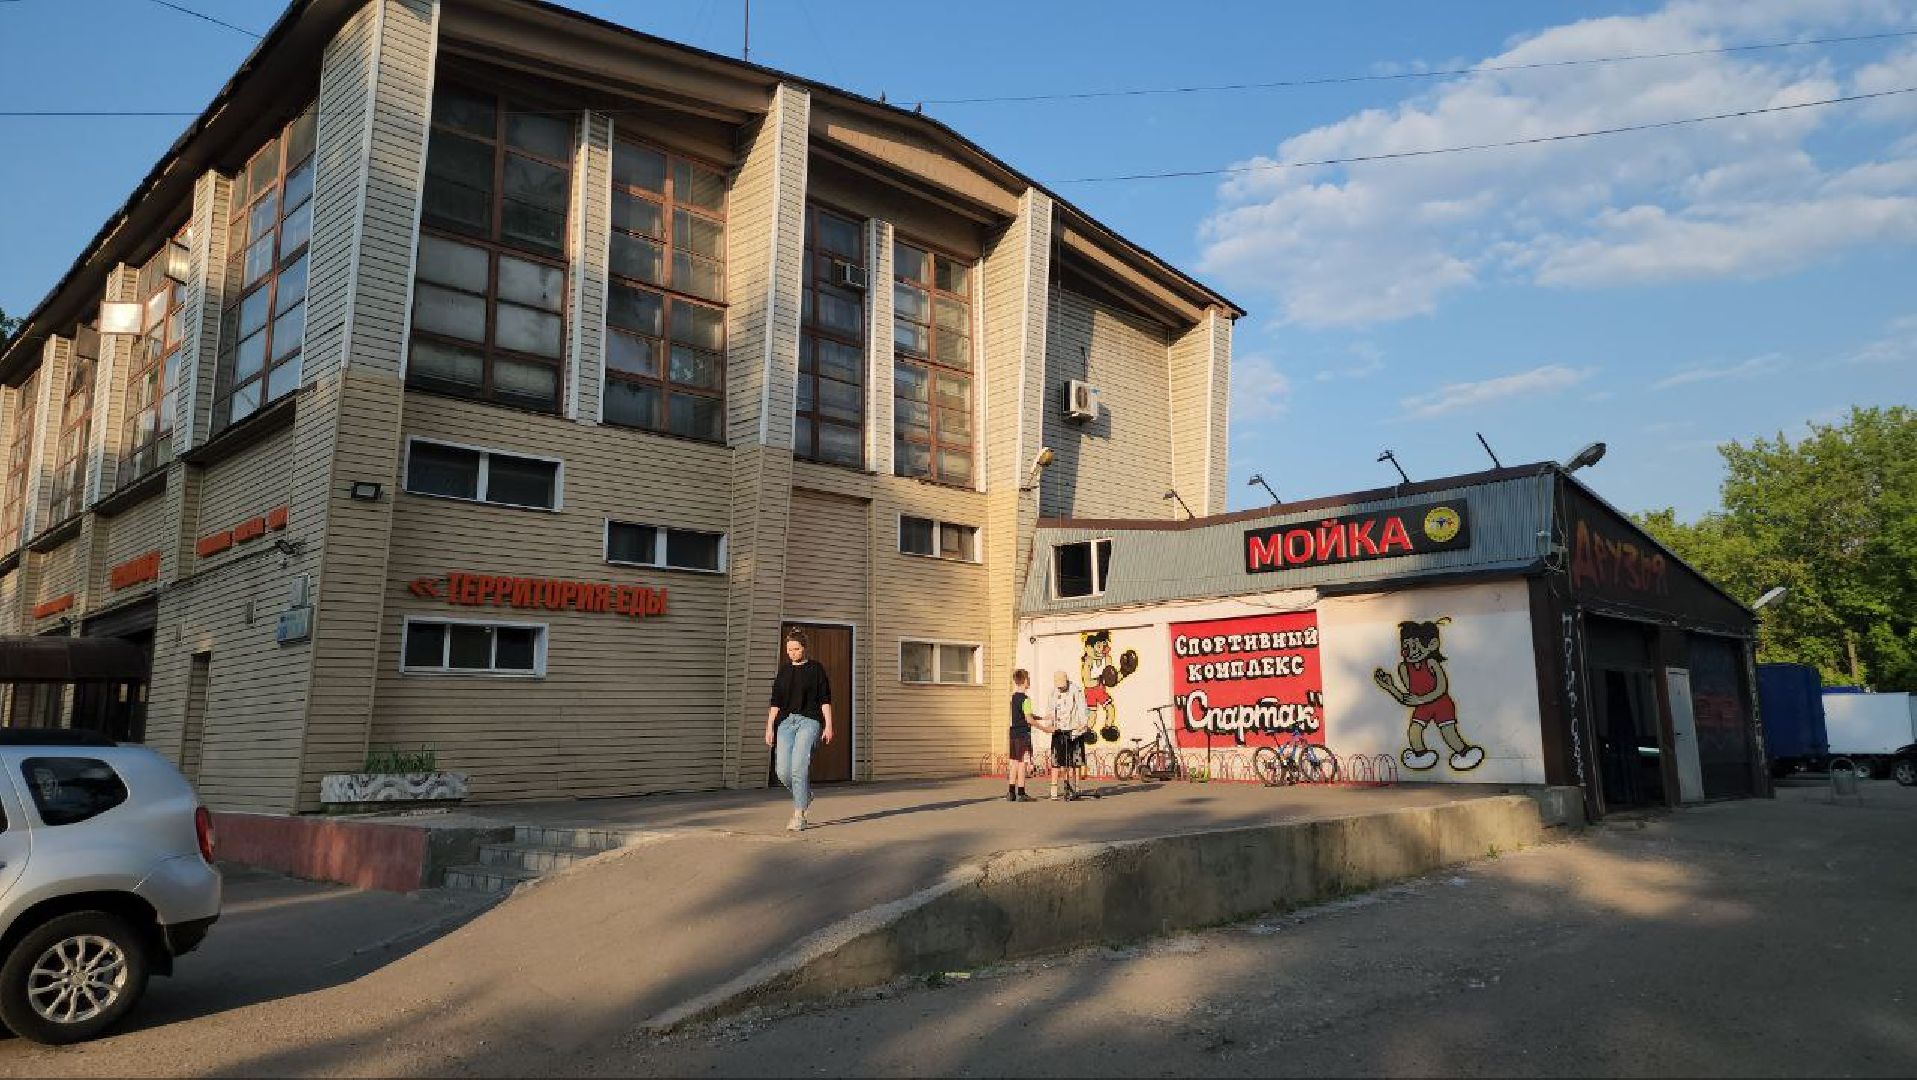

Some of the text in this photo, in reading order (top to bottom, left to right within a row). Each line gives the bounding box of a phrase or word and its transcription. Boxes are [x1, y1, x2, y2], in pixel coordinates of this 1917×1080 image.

[1249, 516, 1413, 570] МОЙКА
[447, 571, 668, 623] ТЕРРИТОРИЯ ЕДЫ
[1187, 654, 1305, 683] КОМПЛЕКС
[1174, 689, 1323, 745] "Спартак"
